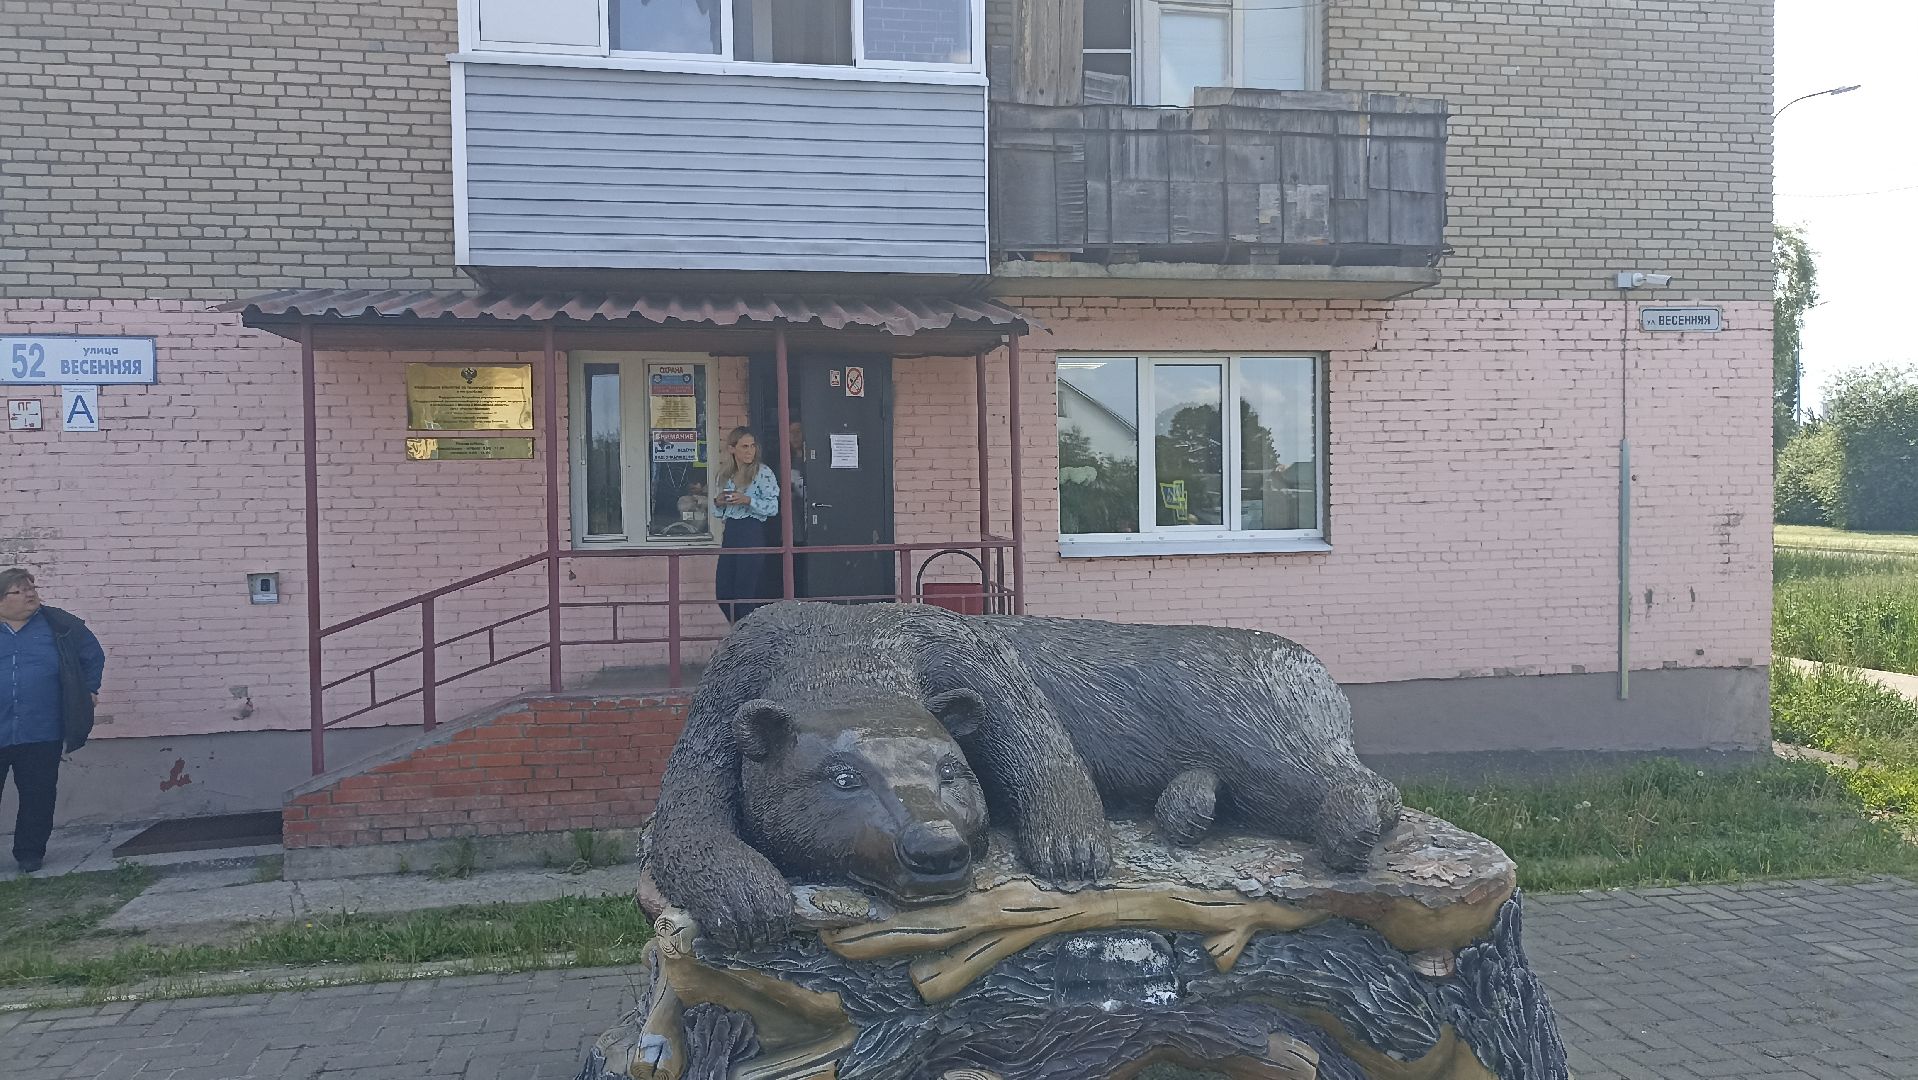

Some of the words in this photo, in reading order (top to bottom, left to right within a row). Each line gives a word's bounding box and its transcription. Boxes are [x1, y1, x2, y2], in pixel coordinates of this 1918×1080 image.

[1658, 315, 1711, 326] ВЕСЕННЯЯ
[83, 347, 120, 356] улица
[11, 342, 46, 379] 52
[60, 359, 142, 375] ВЕСЕННЯЯ
[17, 401, 32, 412] ПГ
